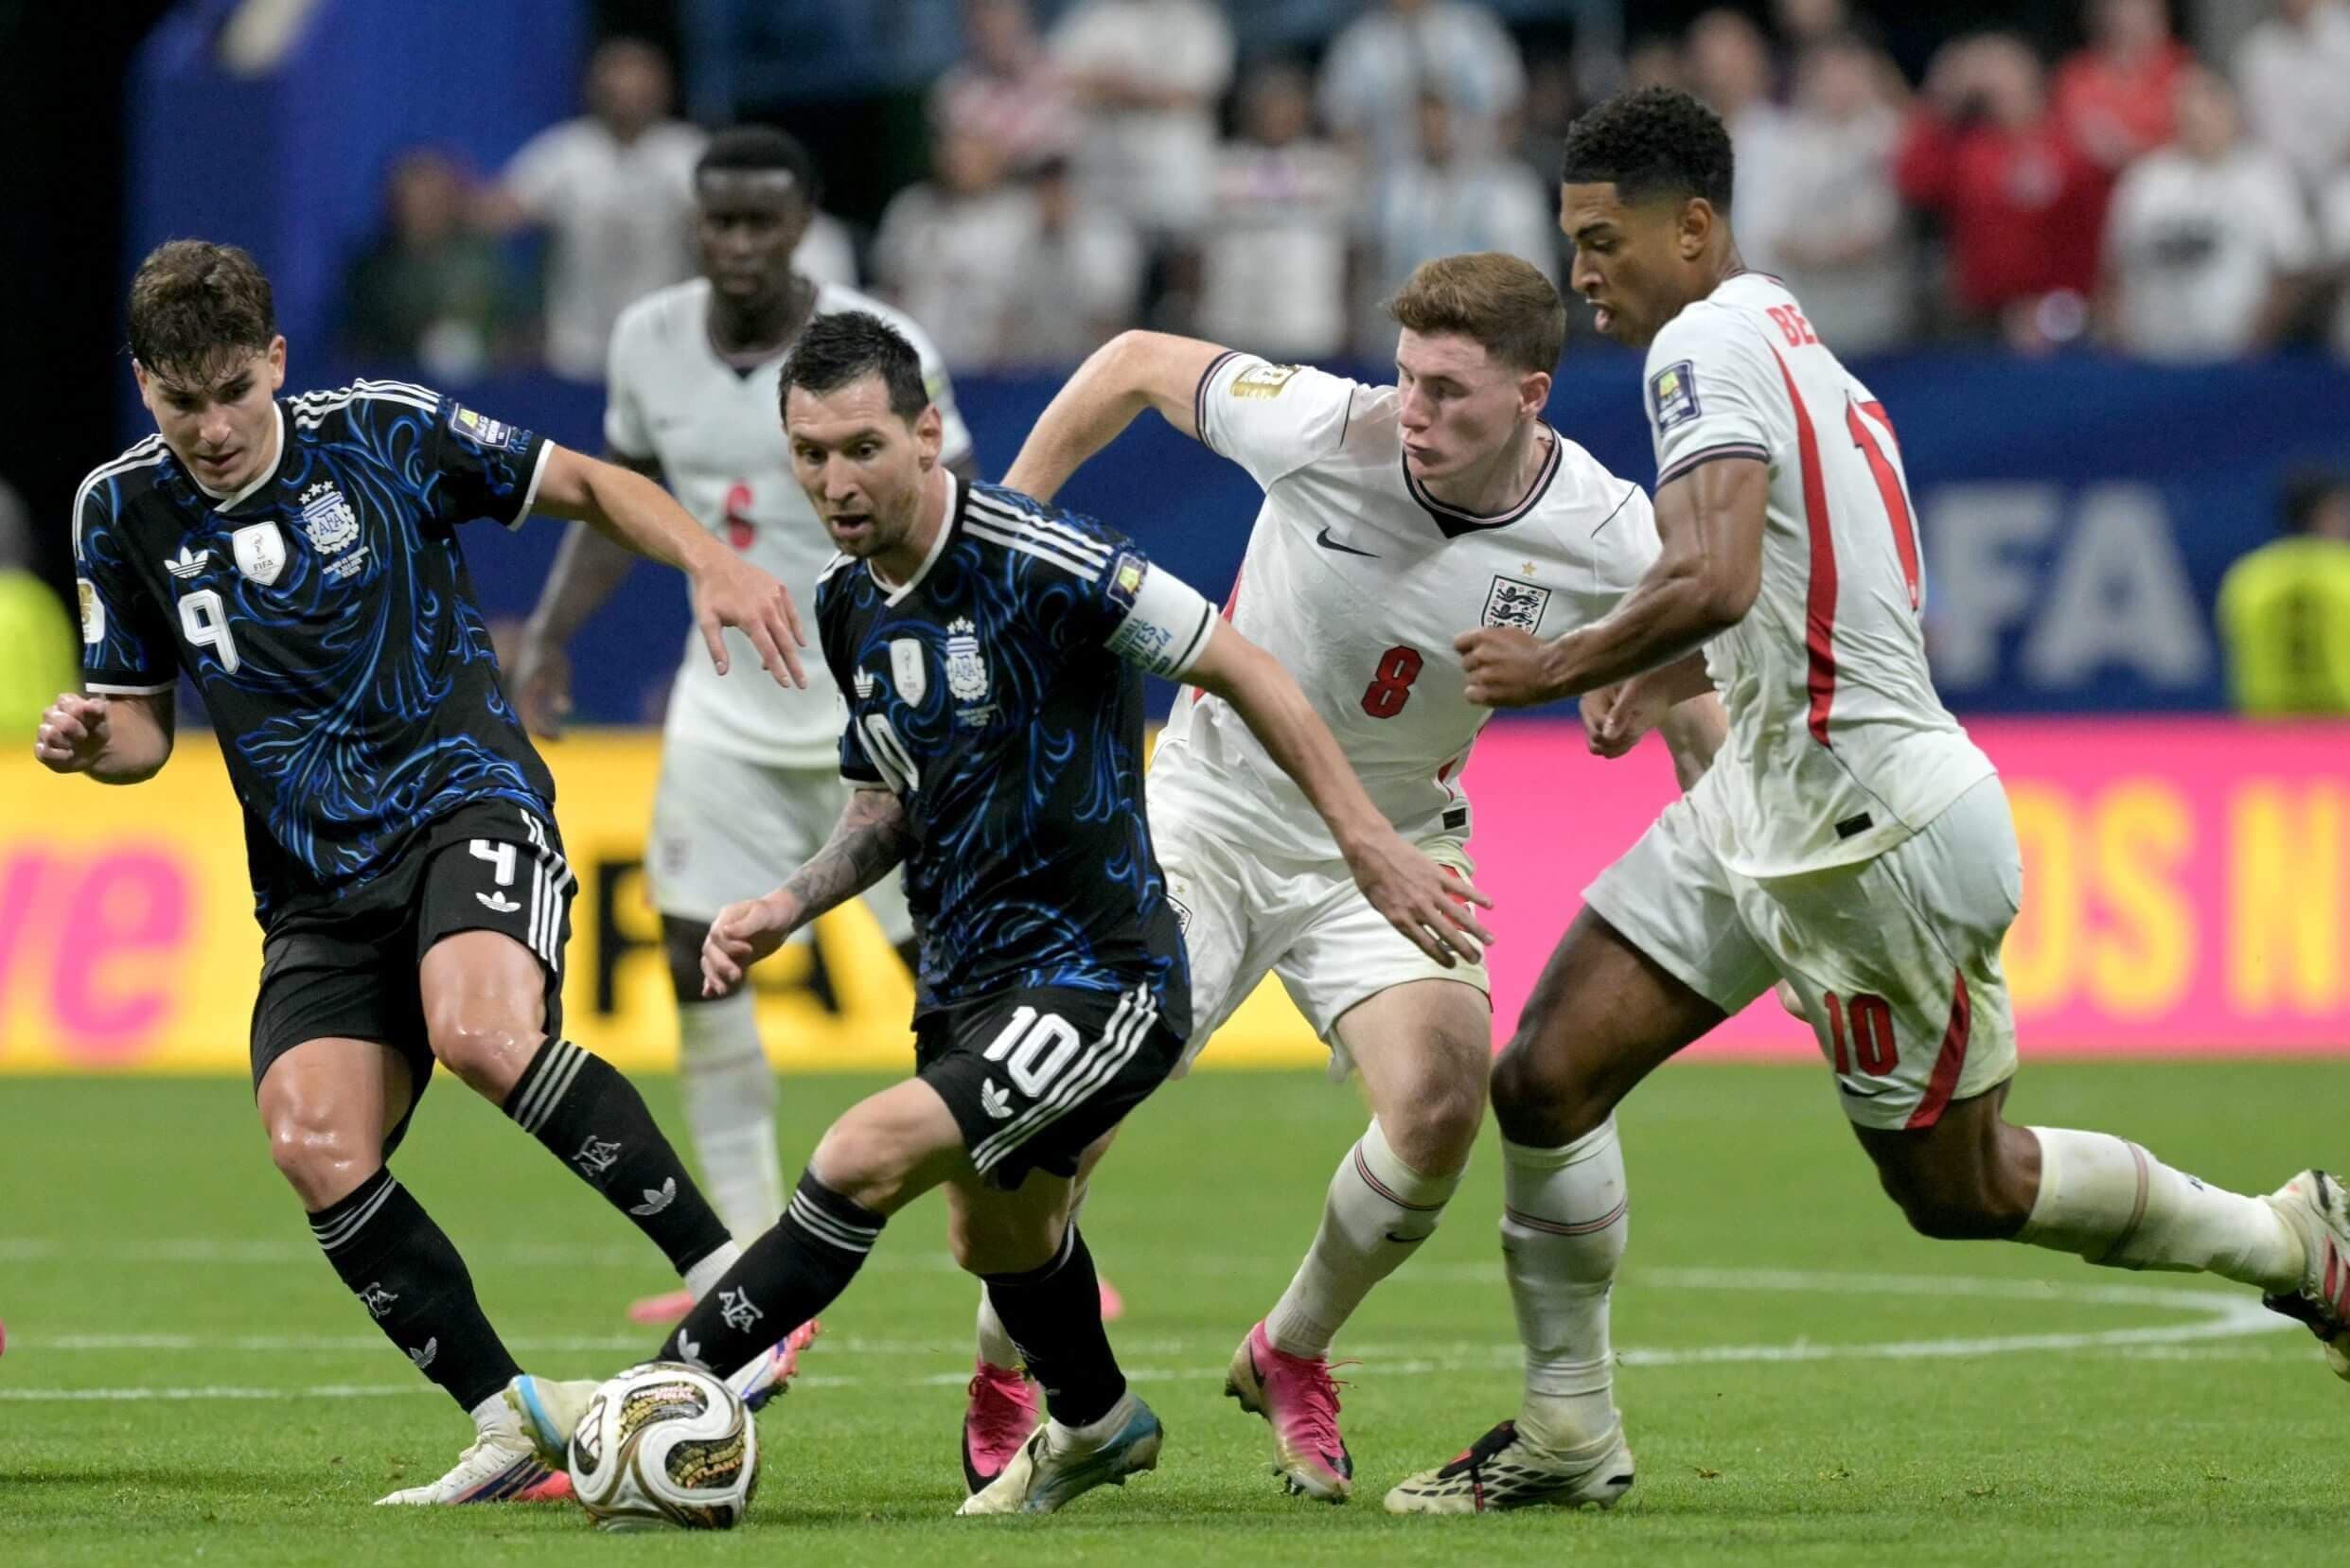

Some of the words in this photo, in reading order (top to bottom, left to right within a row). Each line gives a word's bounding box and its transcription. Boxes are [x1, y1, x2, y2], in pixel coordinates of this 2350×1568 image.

[1765, 303, 1823, 347] BE
[177, 589, 240, 675] 9
[1360, 645, 1423, 719] 8
[982, 1006, 1081, 1098] 10
[1824, 991, 1900, 1077] 10
